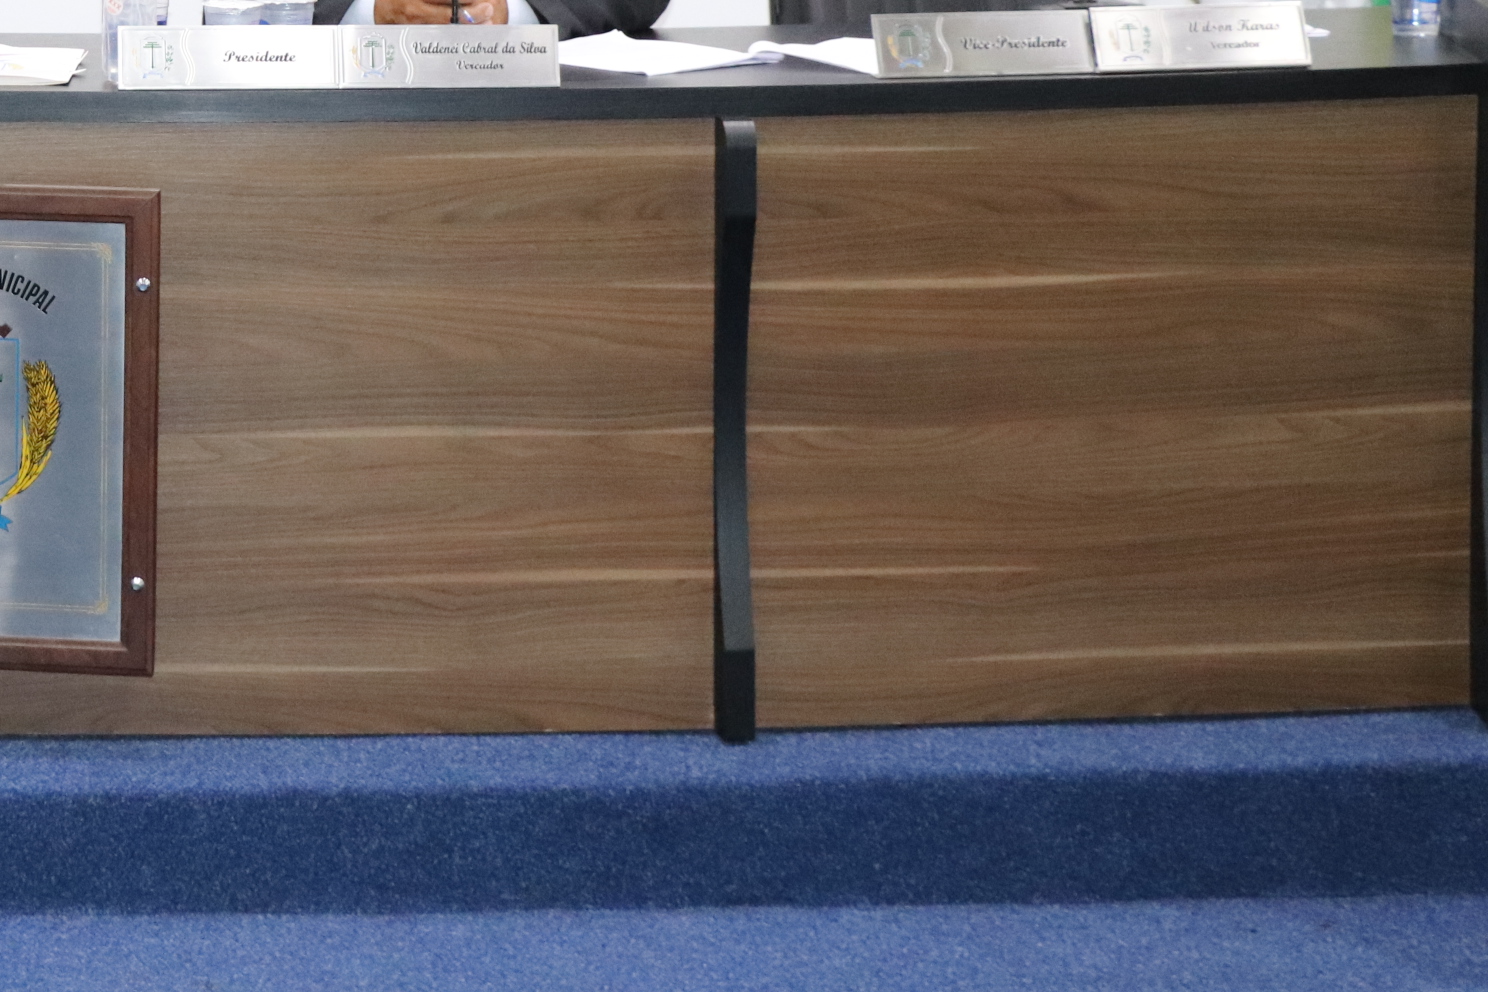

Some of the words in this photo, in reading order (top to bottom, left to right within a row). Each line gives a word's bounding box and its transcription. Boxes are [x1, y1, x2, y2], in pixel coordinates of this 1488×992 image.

[412, 42, 459, 54] Valdenei
[461, 42, 499, 54] Cabral
[501, 42, 516, 54] da
[519, 42, 548, 54] Silva
[222, 50, 297, 63] Presidente
[456, 60, 505, 70] Vereador
